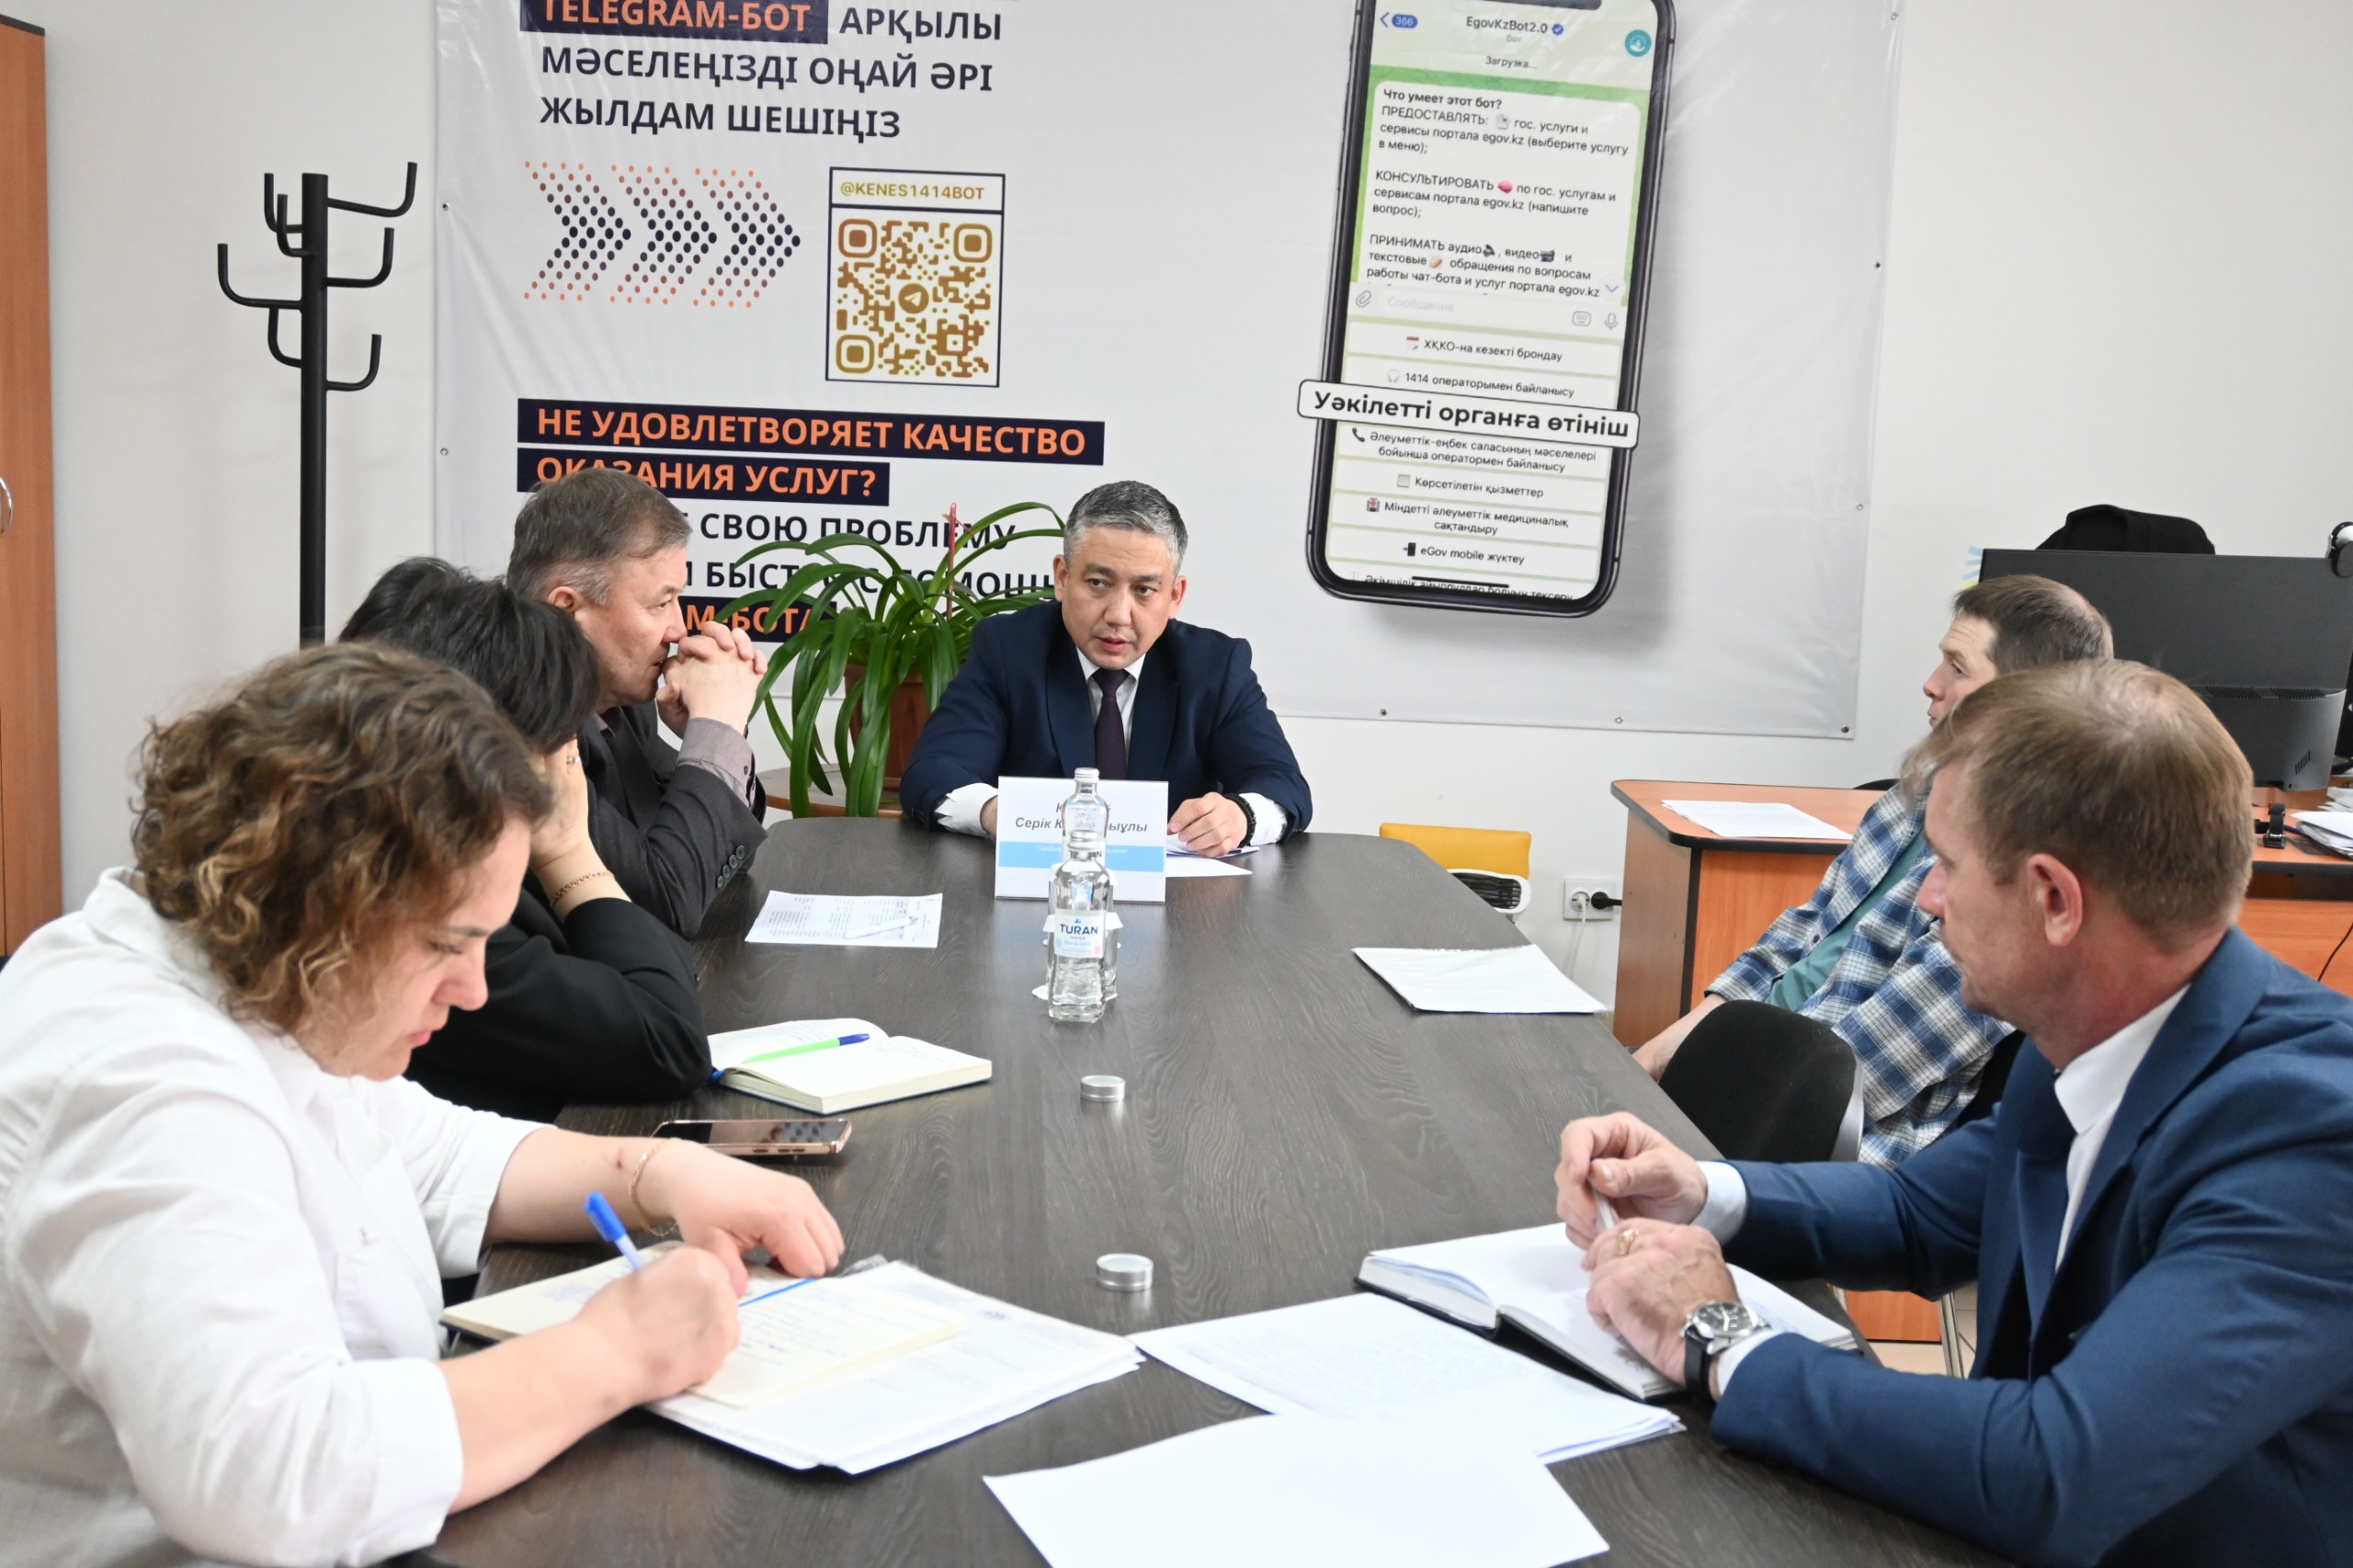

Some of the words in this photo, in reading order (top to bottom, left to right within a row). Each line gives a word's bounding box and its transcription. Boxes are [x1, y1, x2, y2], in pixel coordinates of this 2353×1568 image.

[839, 7, 1001, 44] АРҚЫЛЫ
[1395, 16, 1414, 27] 366
[1466, 17, 1549, 34] EgovKzBot2.0
[541, 47, 797, 90] МӘСЕЛЕҢІЗДІ
[809, 52, 916, 93] ОҢАЙ
[930, 63, 992, 92] ӘРІ
[1485, 56, 1538, 70] Загрузка...
[1383, 88, 1404, 100] Что
[1408, 93, 1444, 106] умеет
[1447, 96, 1472, 107] этот
[1475, 97, 1502, 108] бот?
[540, 97, 713, 135] ЖЫЛДАМ
[728, 104, 901, 143] ШЕШІҢІЗ
[1381, 106, 1488, 125] ПРЕДОСТАВЛЯТЬ:
[1515, 119, 1537, 130] гос.
[1540, 121, 1578, 135] услуги
[1379, 140, 1385, 148] в
[1388, 140, 1427, 154] меню);
[1381, 123, 1430, 137] сервисы
[1433, 128, 1479, 142] портала
[1483, 131, 1524, 145] egov.kz
[1528, 135, 1586, 151] (выберите
[1591, 142, 1628, 156] услугу
[840, 180, 984, 201] @KENES1414BOT
[1376, 170, 1494, 190] КОНСУЛЬТИРОВАТЬ
[1517, 185, 1530, 194] по
[1534, 187, 1555, 196] гос.
[1559, 188, 1606, 203] услугам
[1608, 193, 1616, 201] и
[1372, 204, 1422, 219] вопрос);
[1374, 188, 1430, 204] сервисам
[1433, 192, 1480, 208] портала
[1483, 196, 1524, 210] egov.kz
[1528, 200, 1588, 215] (напишите
[1370, 234, 1445, 251] ПРИНИМАТЬ
[1448, 241, 1482, 256] аудио
[1506, 247, 1539, 259] видео
[1369, 252, 1427, 266] текстовые
[1450, 258, 1514, 275] обращения
[1518, 265, 1531, 274] по
[1535, 266, 1591, 282] вопросам
[1367, 267, 1408, 283] работы
[1411, 270, 1461, 284] чат-бота
[1474, 278, 1506, 291] услуг
[1509, 280, 1555, 294] портала
[1559, 284, 1599, 298] egov.kz
[1425, 339, 1473, 354] ХҚКО-на
[1476, 344, 1514, 357] кезекті
[1517, 347, 1563, 363] брондау
[1405, 372, 1428, 384] 1414
[1432, 376, 1512, 392] операторымен
[1516, 381, 1574, 398] байланысу
[1314, 391, 1431, 419] Уәкілетті
[1439, 404, 1540, 430] органға
[1548, 415, 1629, 437] өтініш
[538, 408, 581, 436] НЕ
[591, 410, 892, 449] УДОВЛЕТВОРЯЕТ
[904, 421, 1086, 457] КАЧЕСТВО
[1370, 431, 1468, 450] Әлеуметтік-еңбек
[1471, 440, 1531, 456] саласының
[1535, 446, 1597, 461] мәселелері
[1379, 447, 1428, 461] бойынша
[1431, 451, 1504, 468] оператормен
[1506, 457, 1565, 473] байланысу
[745, 462, 875, 497] УСЛУГ?
[1415, 477, 1483, 492] Көрсетілетін
[1486, 483, 1543, 499] қызметтер
[700, 513, 807, 540] СВОЮ
[1385, 502, 1430, 517] Міндетті
[1433, 506, 1491, 521] әлеуметтік
[1494, 512, 1568, 528] медициналық
[1435, 520, 1498, 537] сақтандыру
[1421, 547, 1447, 558] eGov
[1449, 549, 1484, 562] mobile
[1487, 551, 1525, 566] жүктеу
[1015, 817, 1051, 830] Серік
[1060, 924, 1098, 935] TURAN
